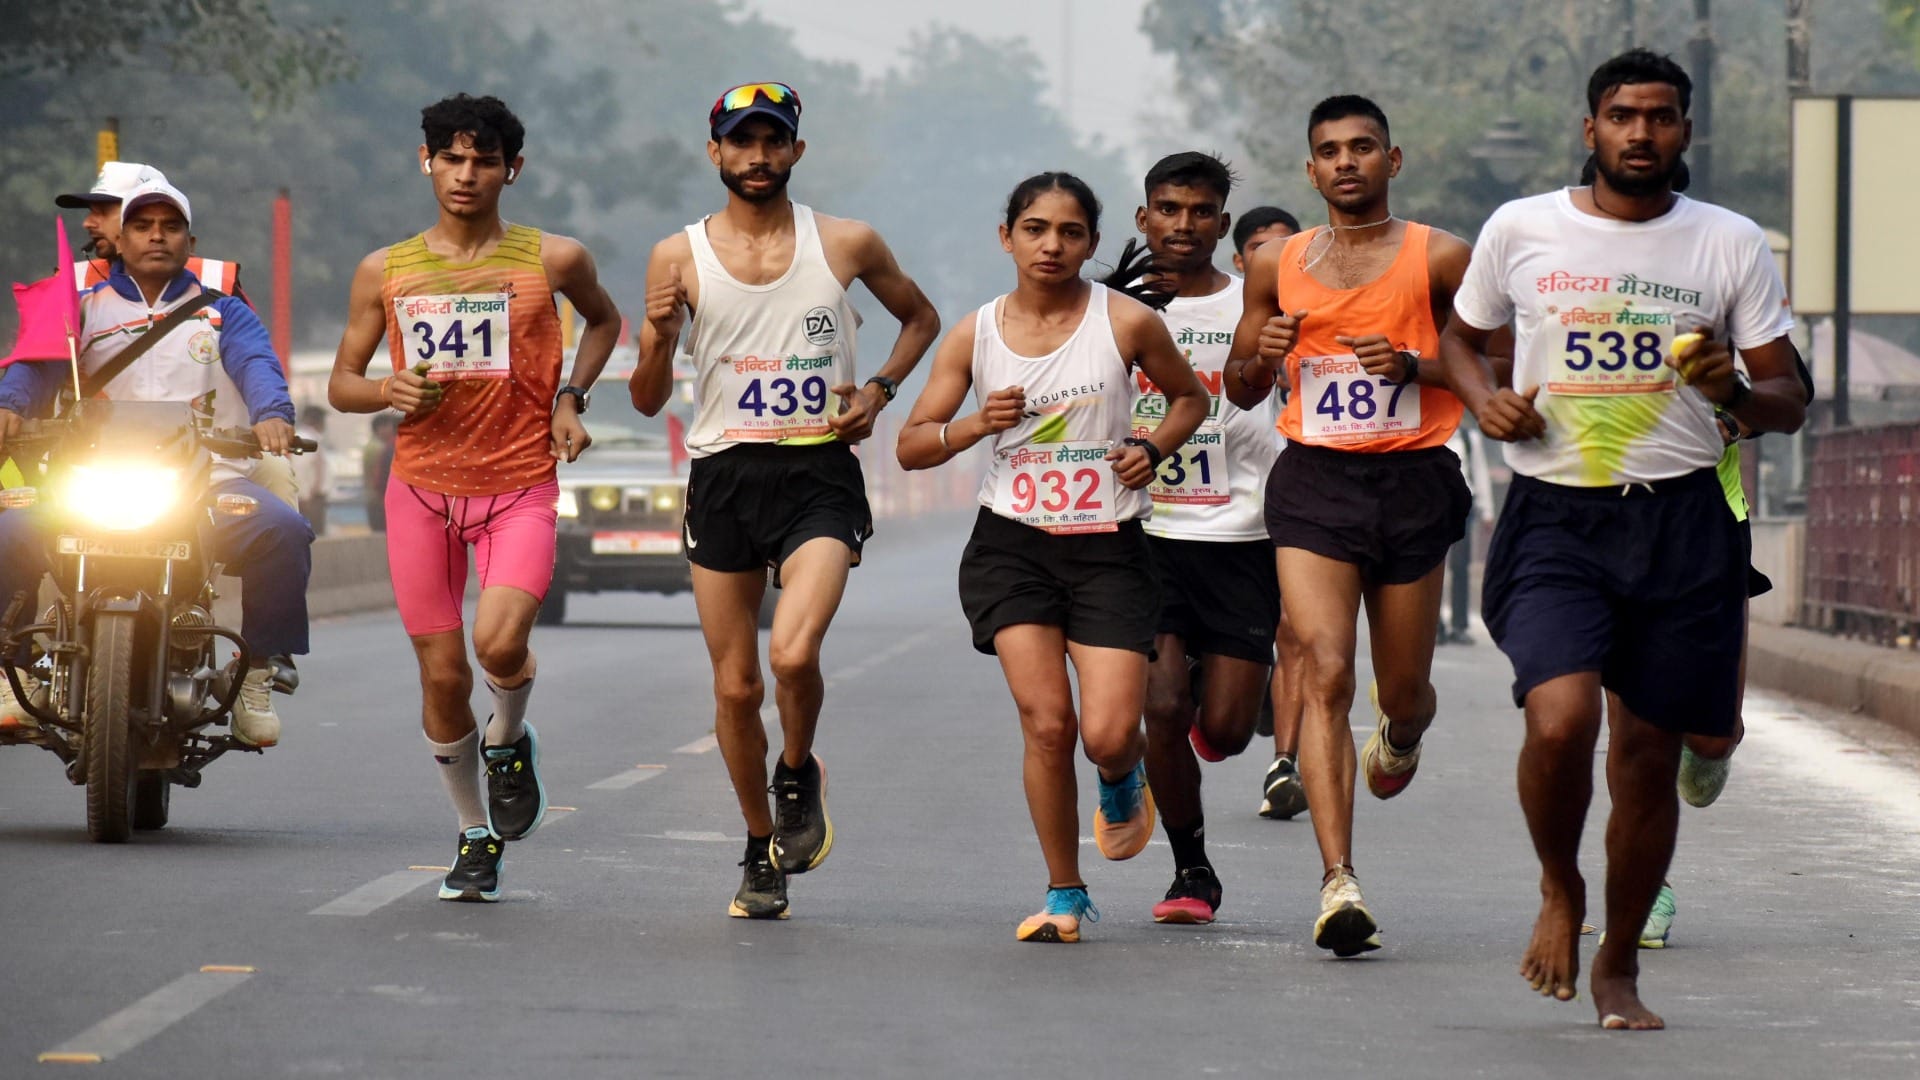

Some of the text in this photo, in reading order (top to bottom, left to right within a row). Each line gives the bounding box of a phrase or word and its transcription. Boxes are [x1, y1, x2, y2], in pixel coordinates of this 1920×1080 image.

[1536, 271, 1702, 307] इन्दिरा मैराथन
[406, 296, 507, 318] इन्दिरा मैराथन
[1560, 307, 1673, 326] इन्दिरा मैराथन
[413, 319, 492, 359] 341
[1176, 327, 1235, 345] मैराथ
[734, 354, 833, 375] इन्दिरा मैराथन
[1565, 331, 1662, 372] 538
[1312, 358, 1360, 378] इन्दिरा
[738, 376, 827, 417] 439
[1031, 382, 1105, 407] YOURSELF
[1316, 379, 1407, 421] 487
[1056, 445, 1108, 463] मैराथन
[1160, 450, 1211, 486] 31
[1011, 468, 1103, 514] 932
